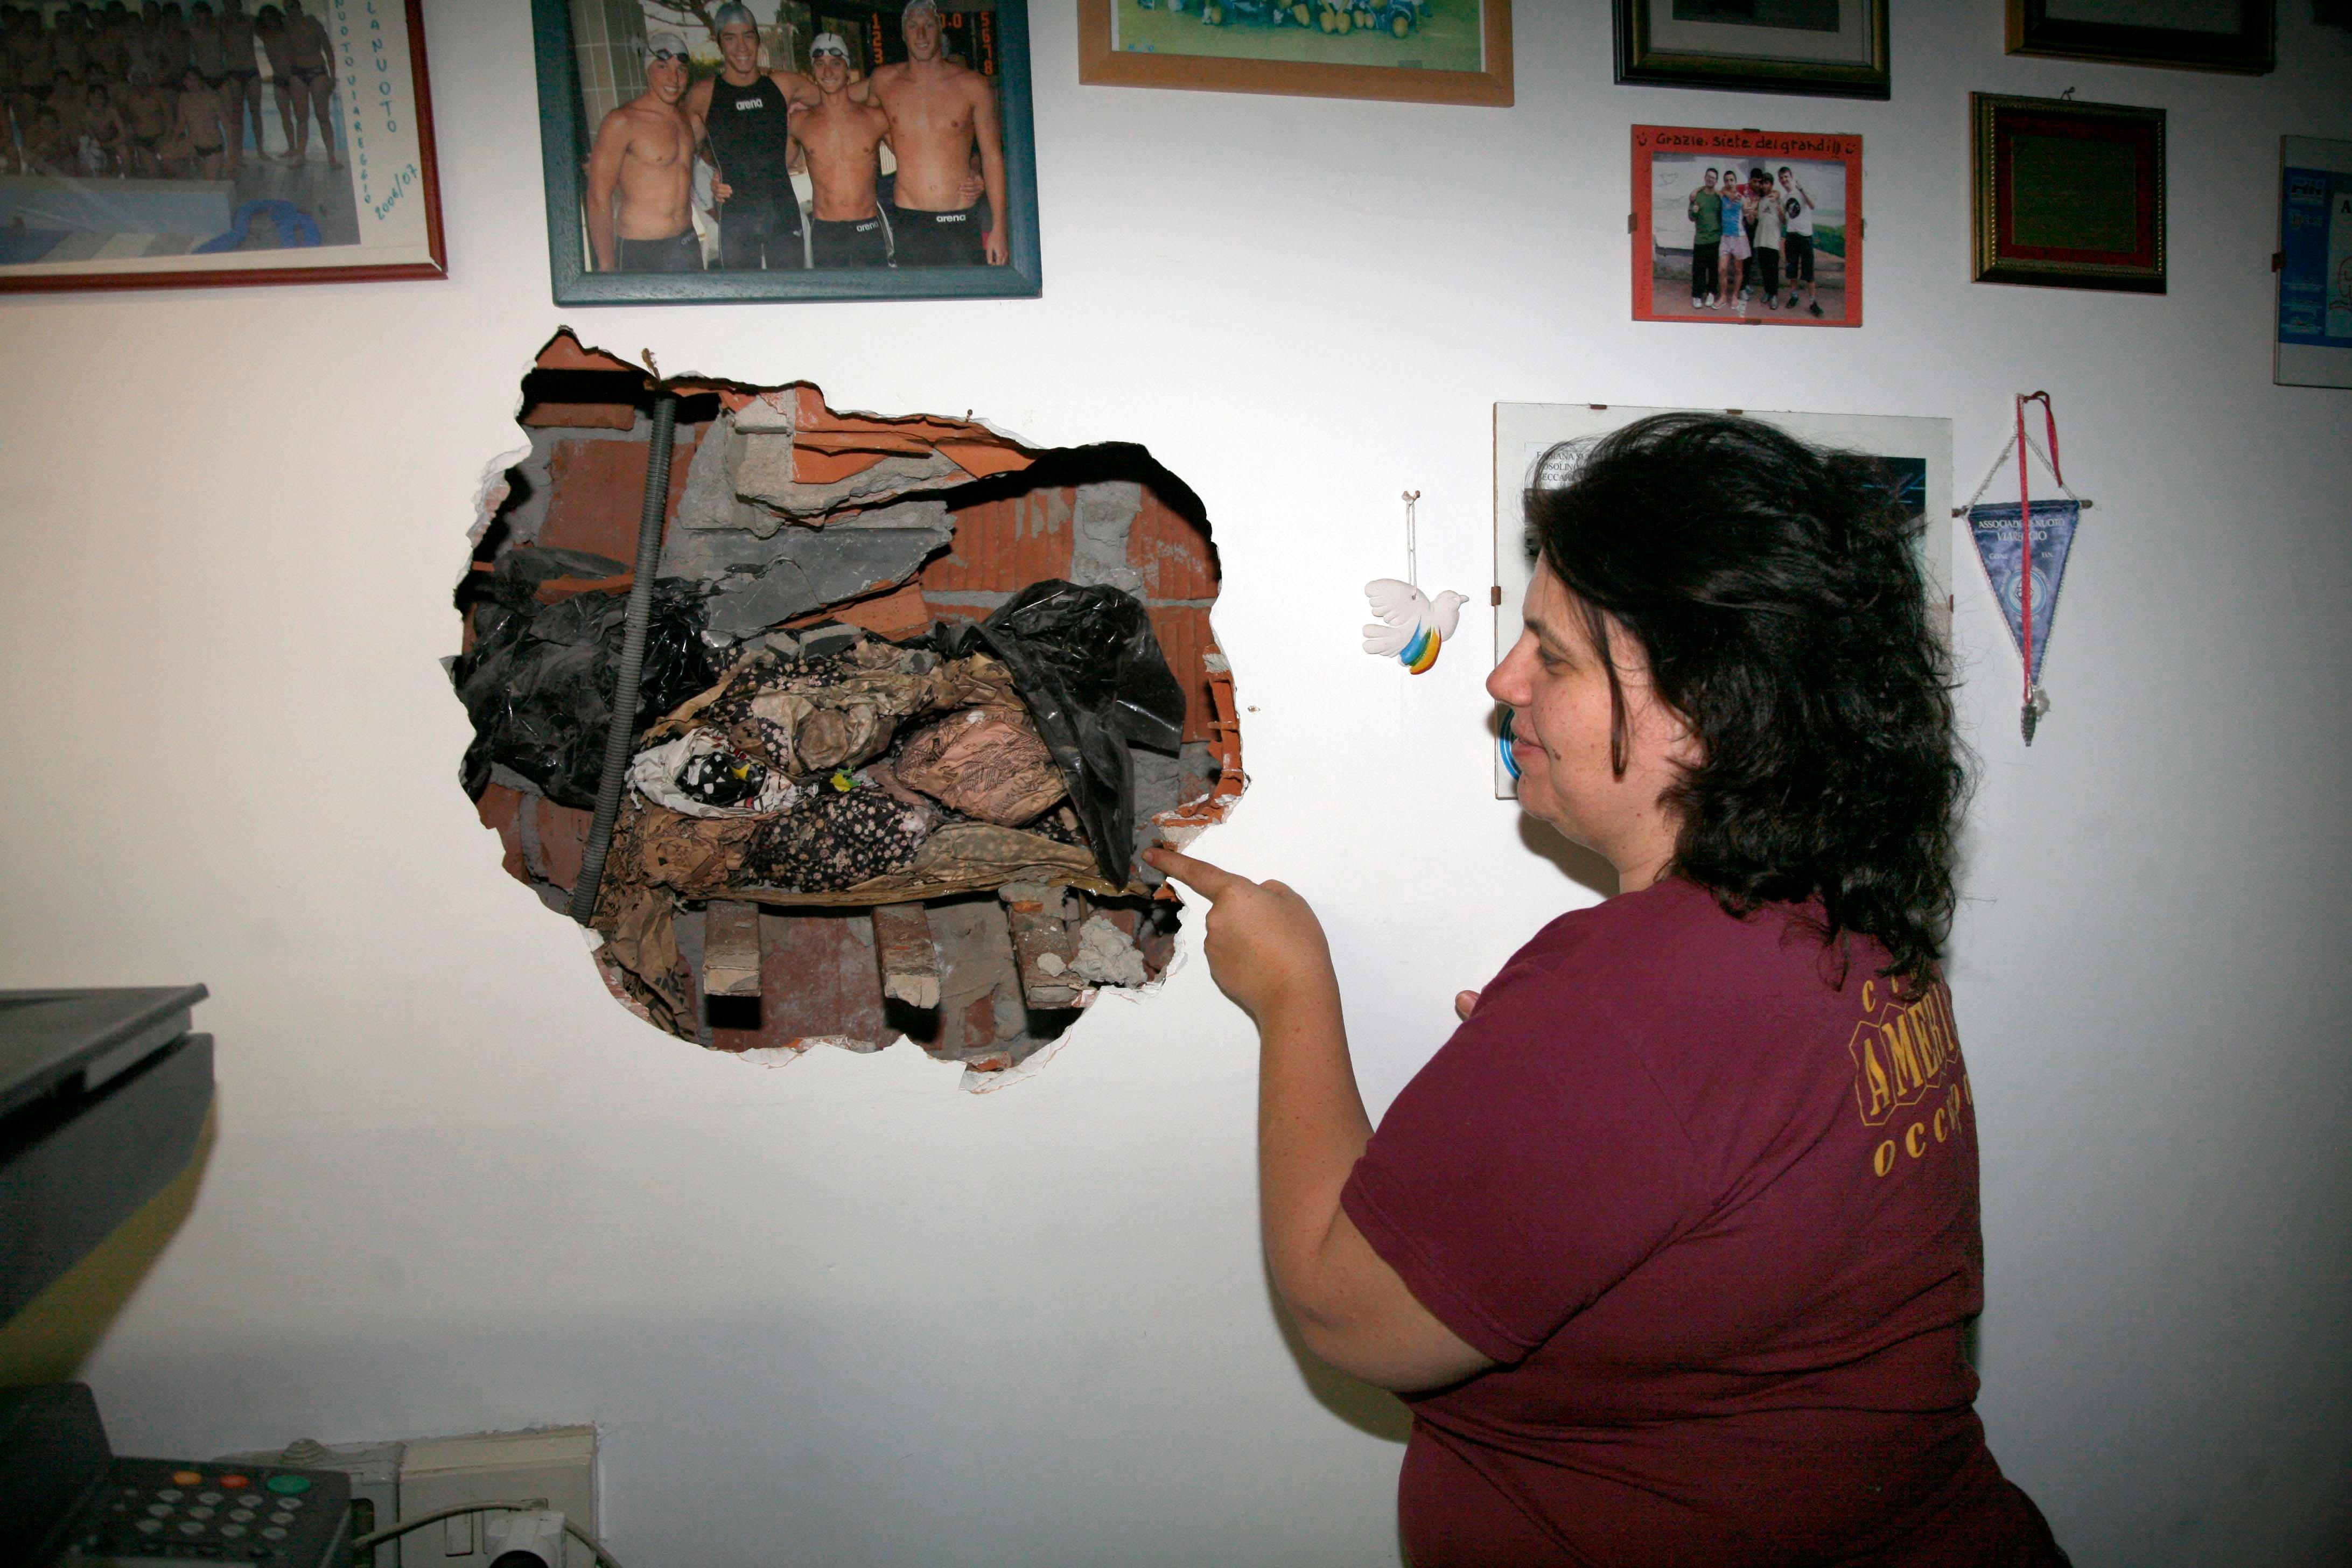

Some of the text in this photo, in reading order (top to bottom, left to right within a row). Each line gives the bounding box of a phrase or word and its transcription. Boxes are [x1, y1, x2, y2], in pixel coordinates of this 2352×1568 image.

[736, 98, 764, 111] arena
[936, 213, 966, 222] arena
[856, 220, 879, 233] arena
